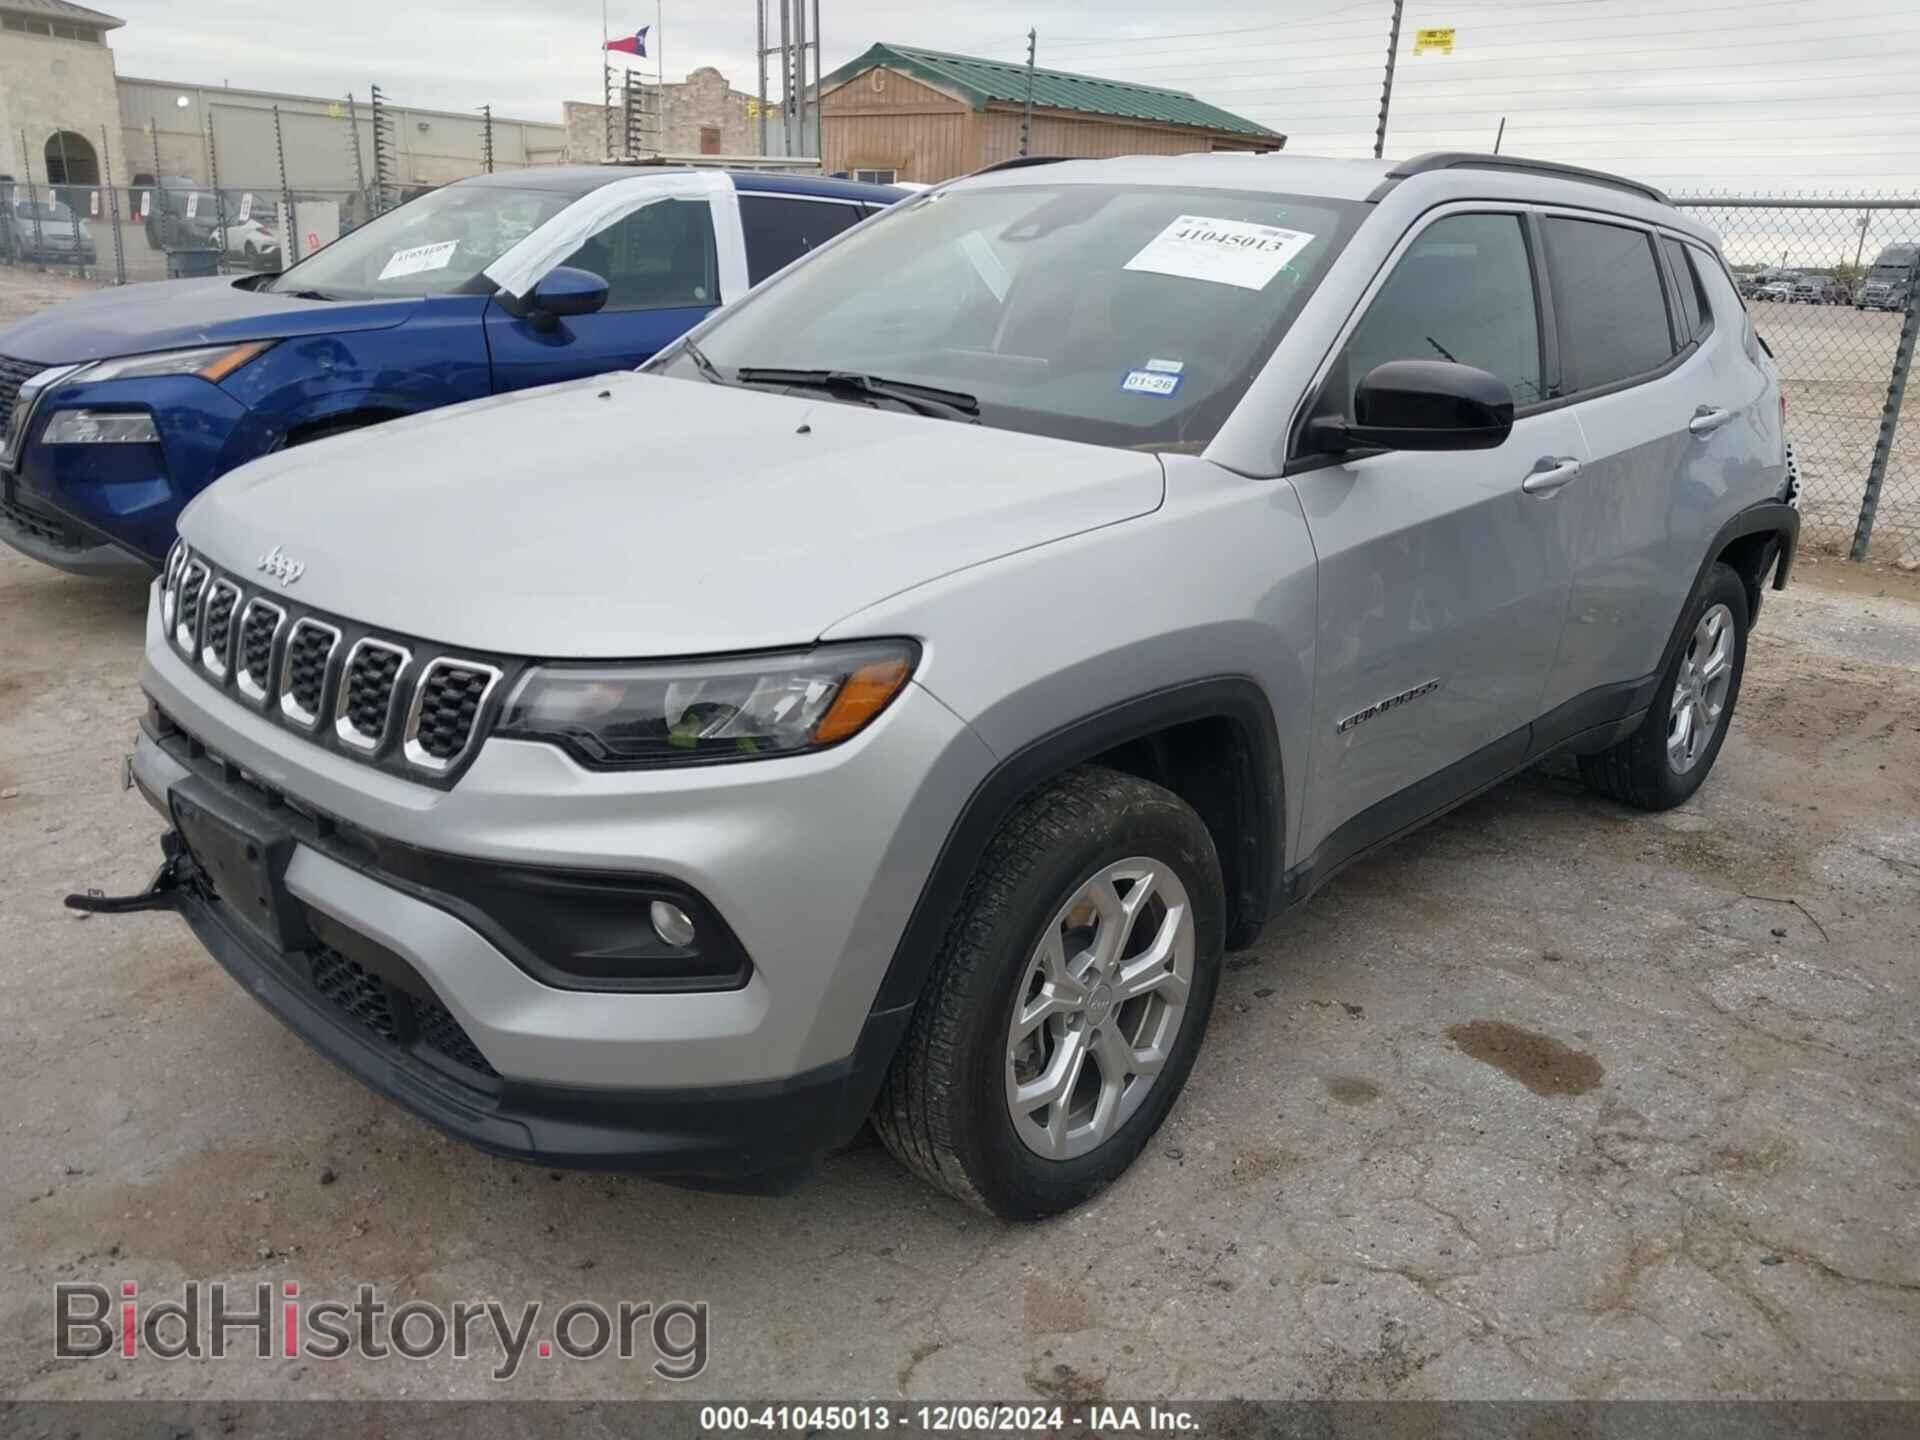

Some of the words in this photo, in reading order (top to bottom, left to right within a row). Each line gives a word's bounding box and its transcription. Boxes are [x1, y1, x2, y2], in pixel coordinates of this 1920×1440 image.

[1176, 228, 1283, 252] 41045013
[258, 545, 305, 587] Jeep
[1337, 677, 1440, 734] COMPASS
